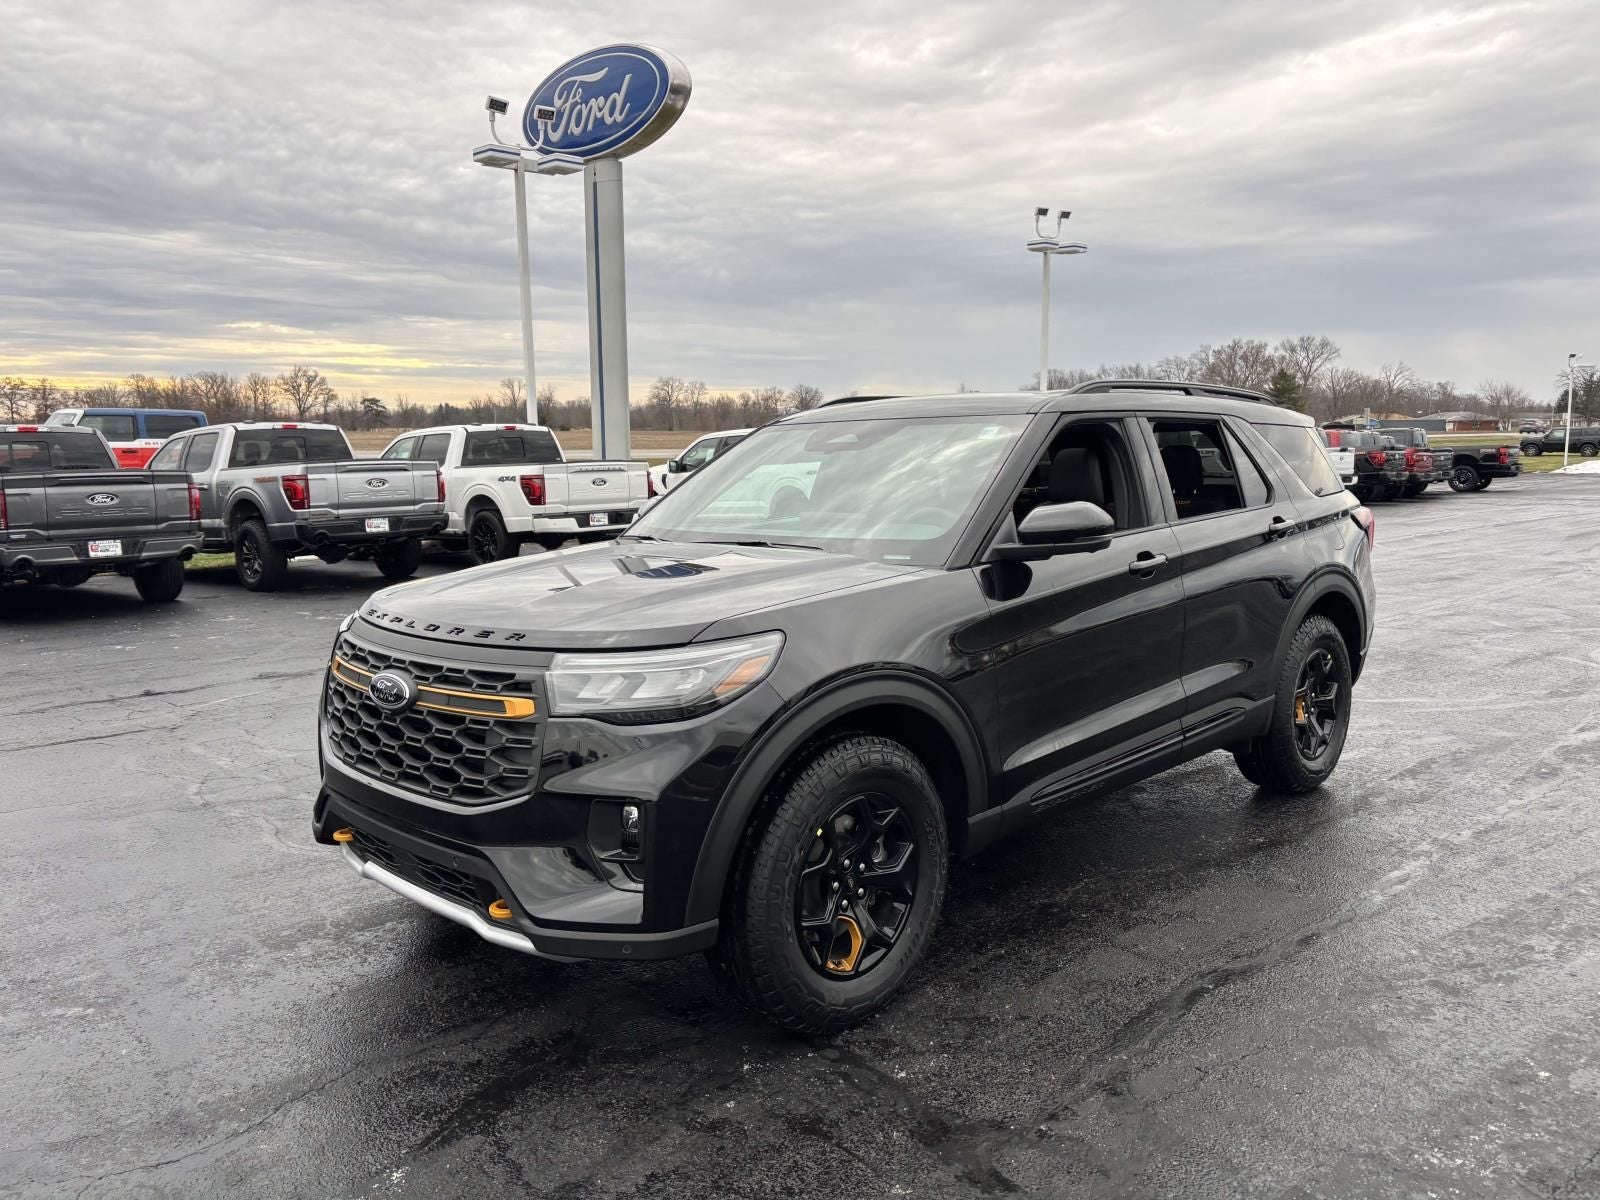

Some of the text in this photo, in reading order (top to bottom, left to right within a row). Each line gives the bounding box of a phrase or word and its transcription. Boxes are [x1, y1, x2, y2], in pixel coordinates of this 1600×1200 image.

[547, 67, 633, 143] Ford
[366, 608, 527, 642] EXPLORER
[373, 679, 398, 702] Ford
